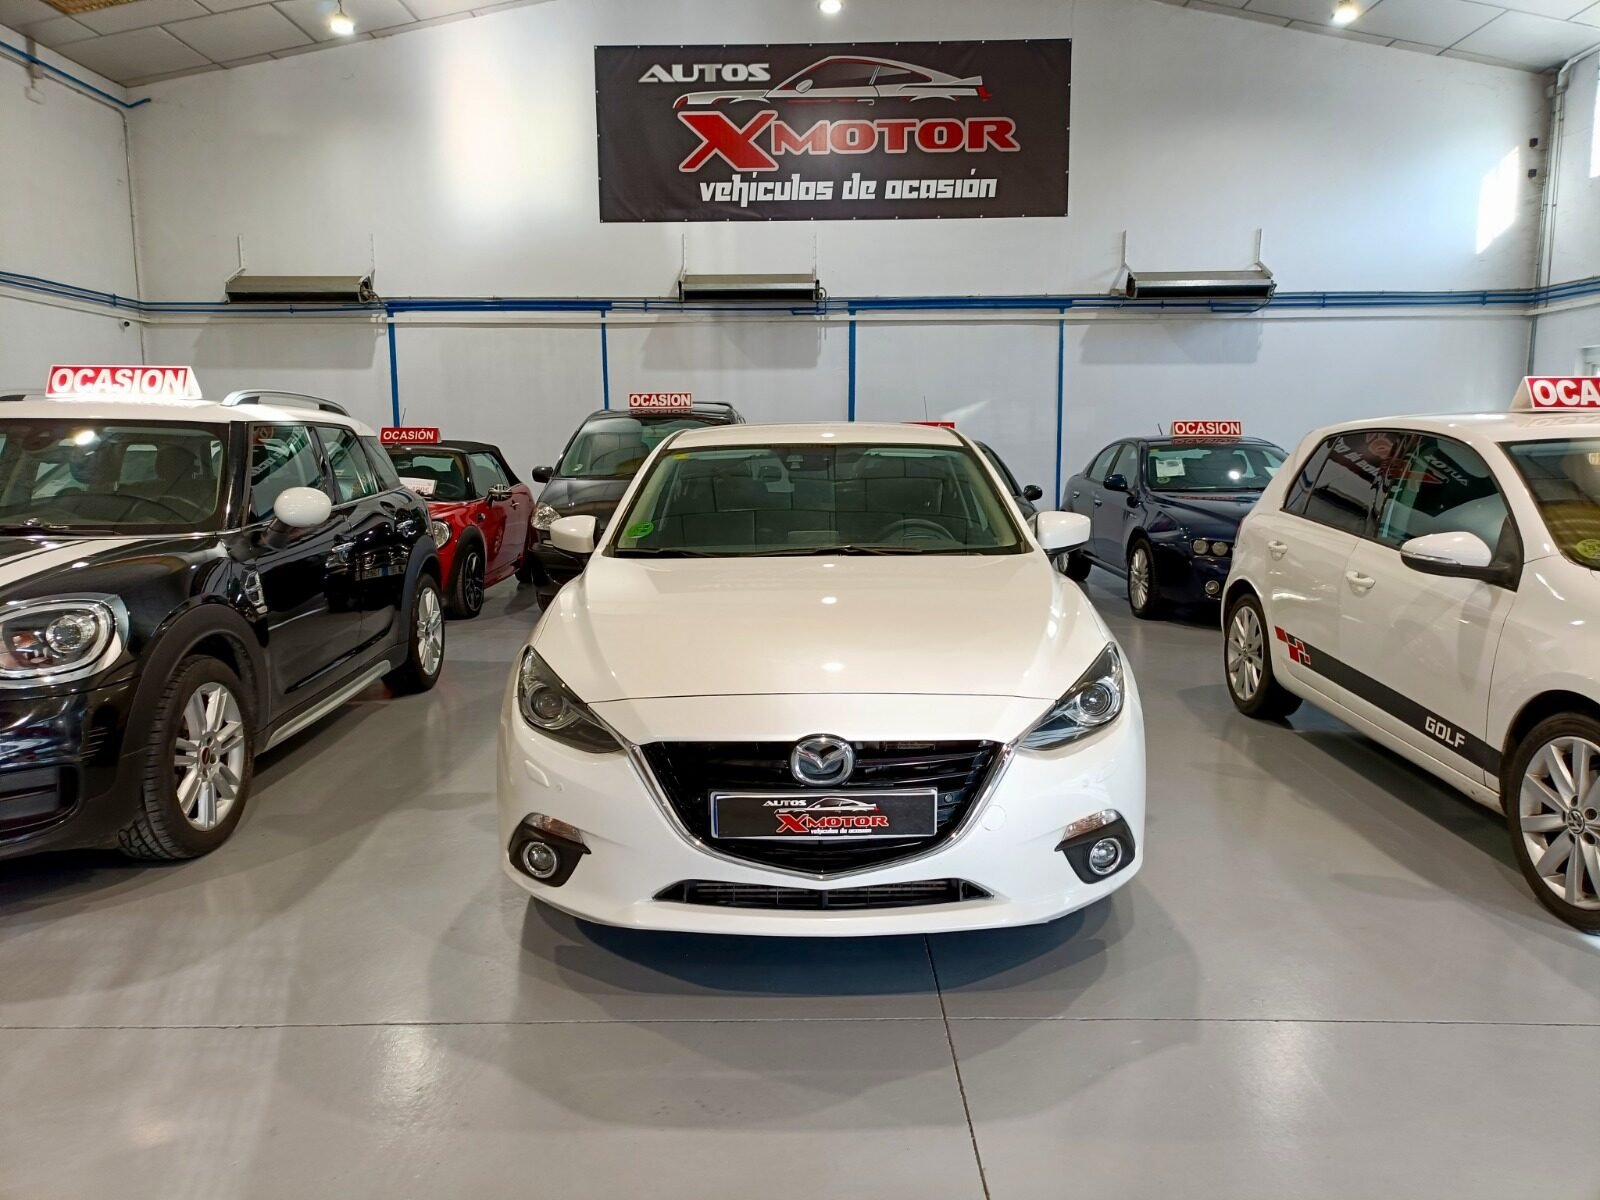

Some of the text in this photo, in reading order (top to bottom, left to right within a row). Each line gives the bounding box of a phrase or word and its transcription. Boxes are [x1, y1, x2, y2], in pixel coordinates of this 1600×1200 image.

[638, 64, 770, 83] AUTOS
[677, 111, 1021, 172] XMOTOR
[700, 168, 998, 207] vehículos de ocasión
[51, 367, 187, 394] OCASION
[630, 394, 691, 407] OCASION
[1532, 379, 1600, 406] OCA
[383, 429, 435, 440] OCASIÓN
[1174, 422, 1241, 435] OCASION
[1425, 715, 1466, 748] GOLF
[763, 799, 807, 807] AUTOS
[776, 813, 889, 833] XMOTOR
